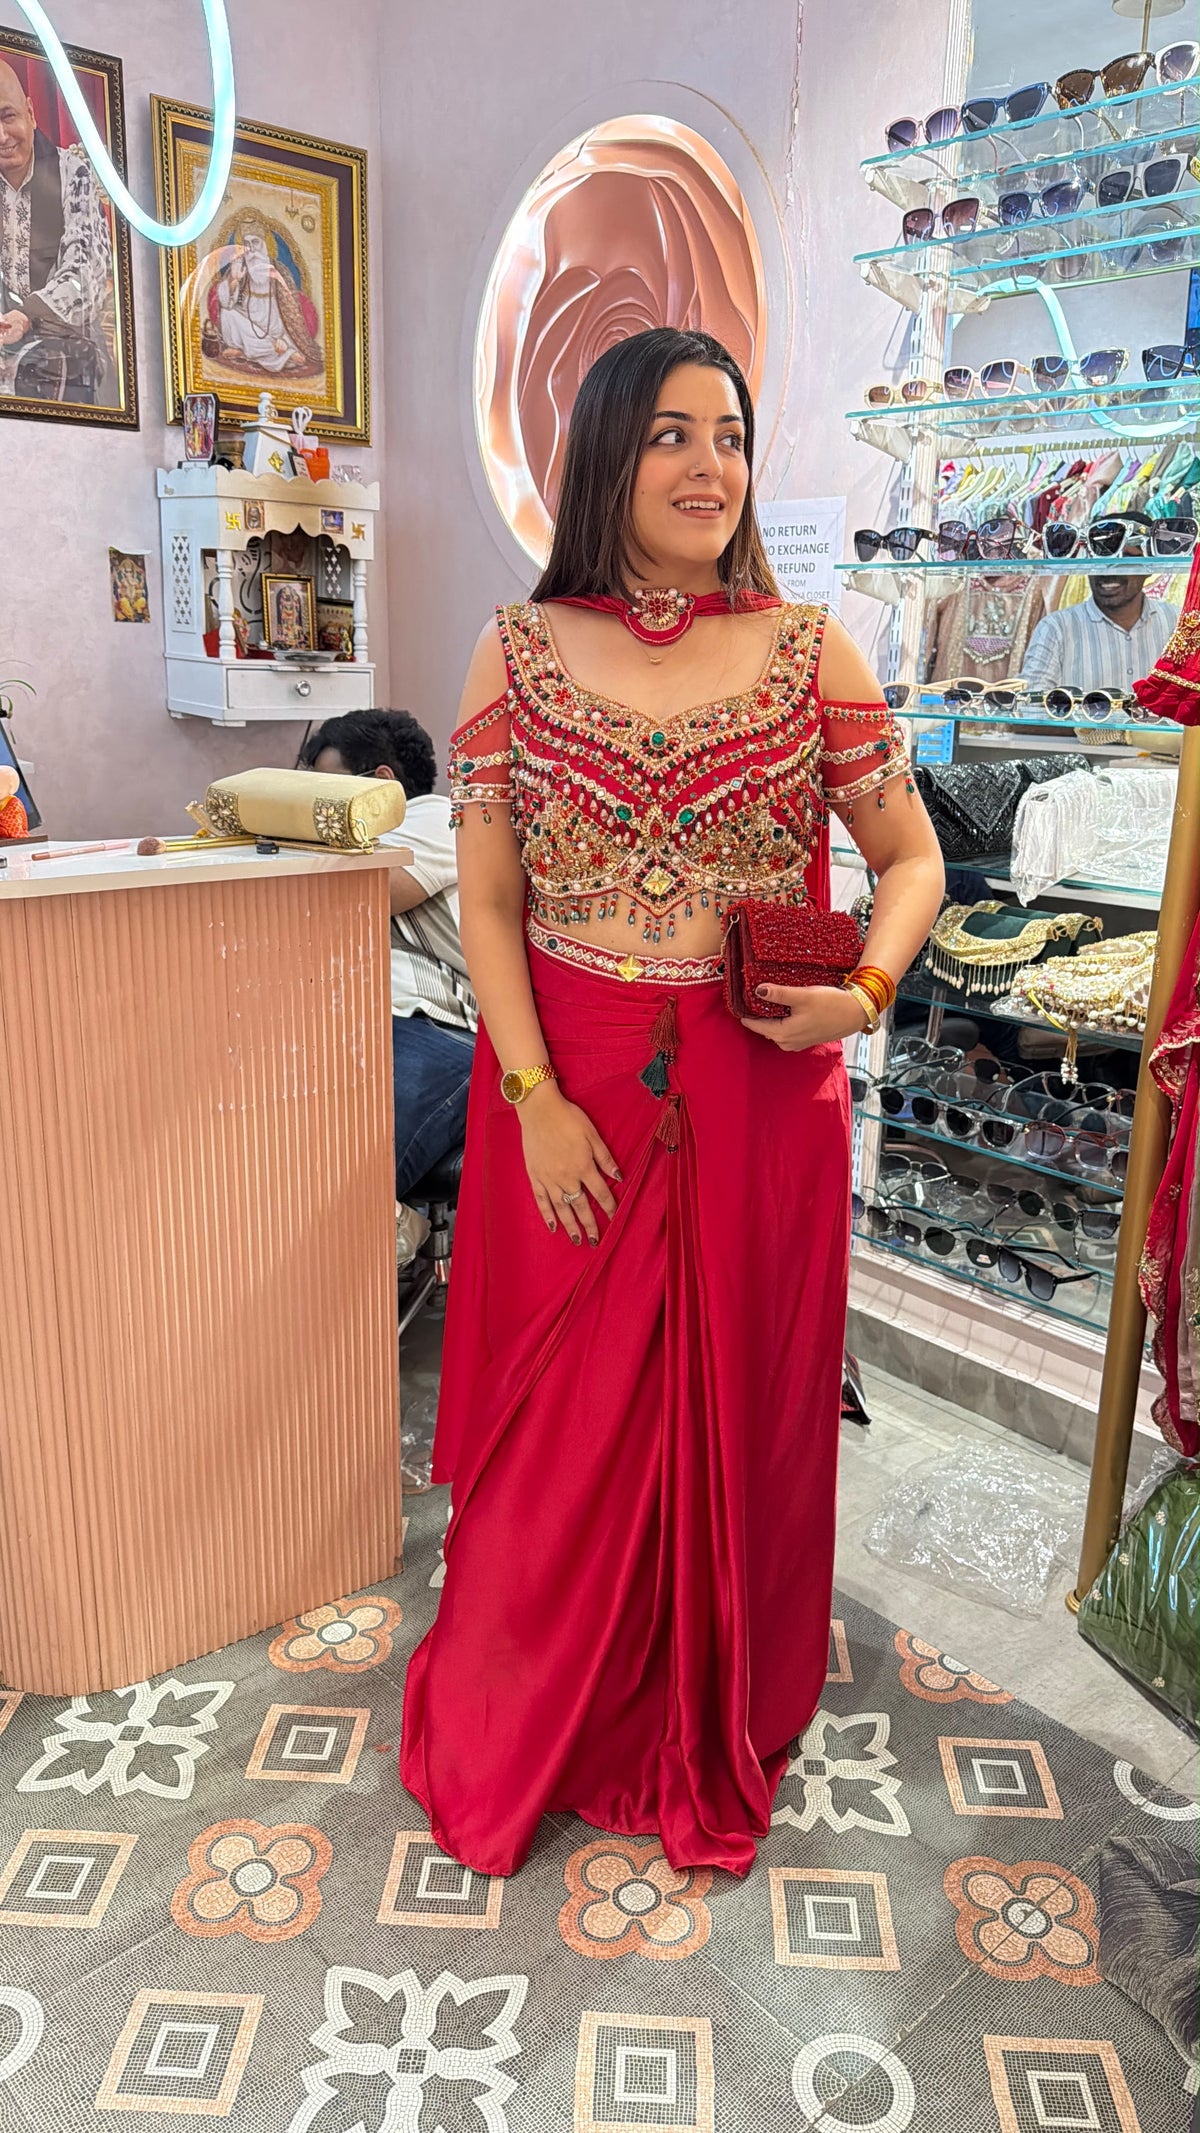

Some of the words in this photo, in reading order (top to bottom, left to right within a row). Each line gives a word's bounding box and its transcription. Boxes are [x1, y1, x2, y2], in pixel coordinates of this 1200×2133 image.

[763, 526, 775, 537] NO
[778, 524, 817, 537] RETURN
[766, 545, 775, 556] O
[778, 543, 830, 555] EXCHANGE
[777, 562, 816, 574] REFUND
[787, 579, 806, 587] FROM
[806, 591, 830, 599] CLOSET
